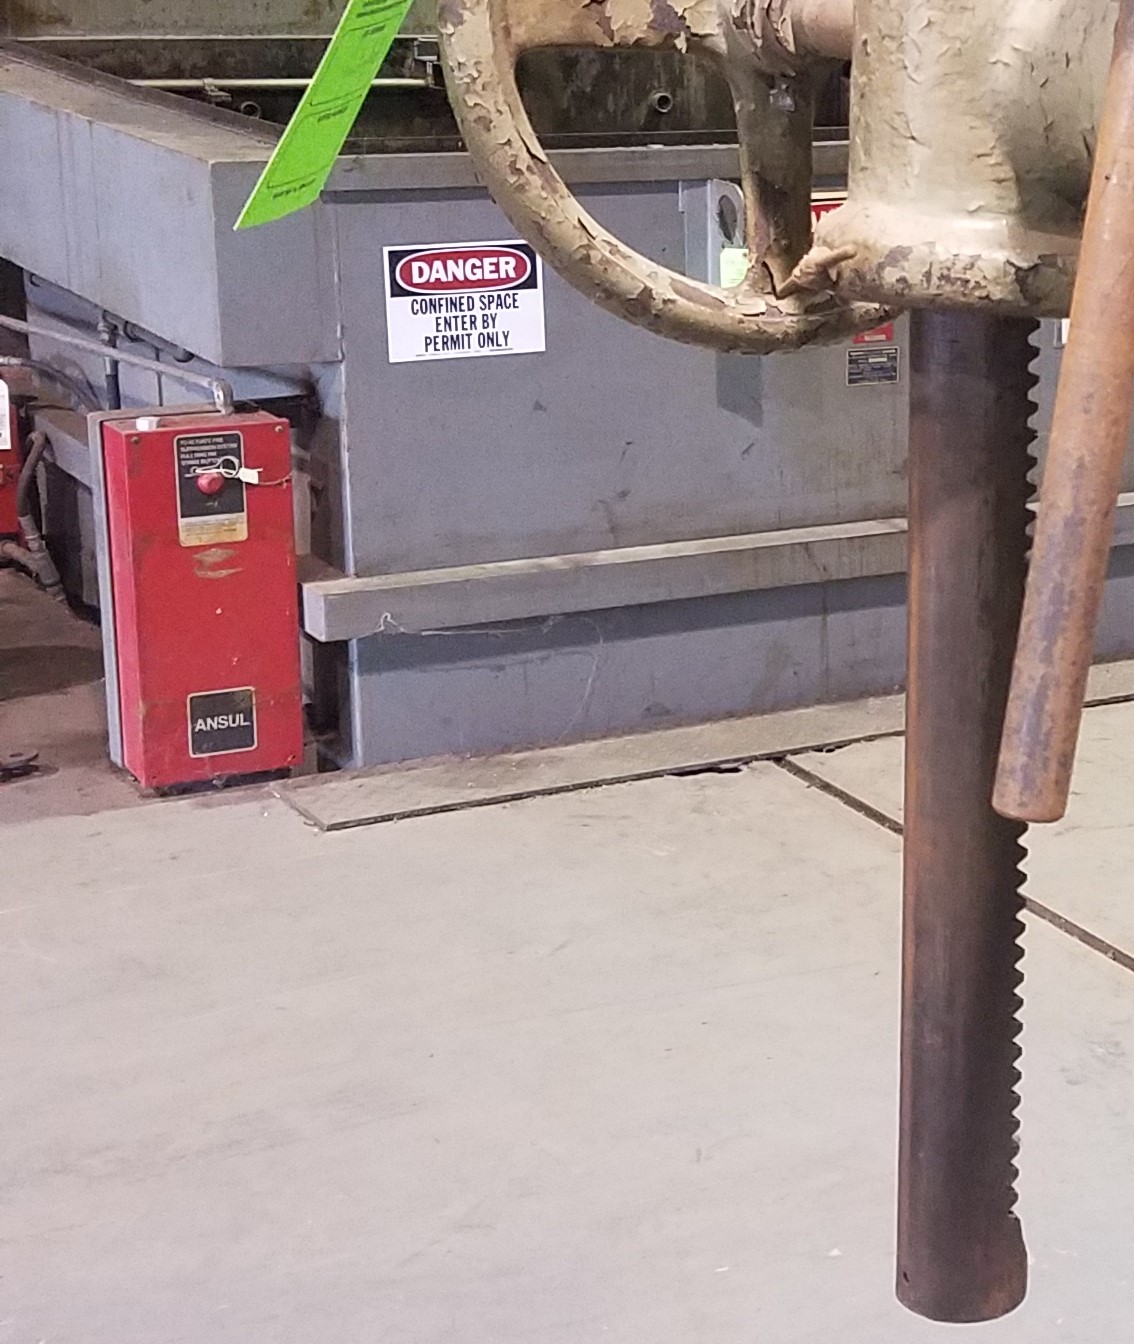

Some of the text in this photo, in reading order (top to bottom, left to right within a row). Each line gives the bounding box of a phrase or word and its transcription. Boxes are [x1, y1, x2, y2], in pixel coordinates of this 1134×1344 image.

[411, 256, 517, 284] DANGER
[411, 293, 519, 316] CONFINED SPACE
[435, 312, 498, 333] ENTER BY
[424, 333, 473, 353] PERMIT
[478, 330, 510, 349] ONLY
[195, 713, 251, 732] ANSUL
